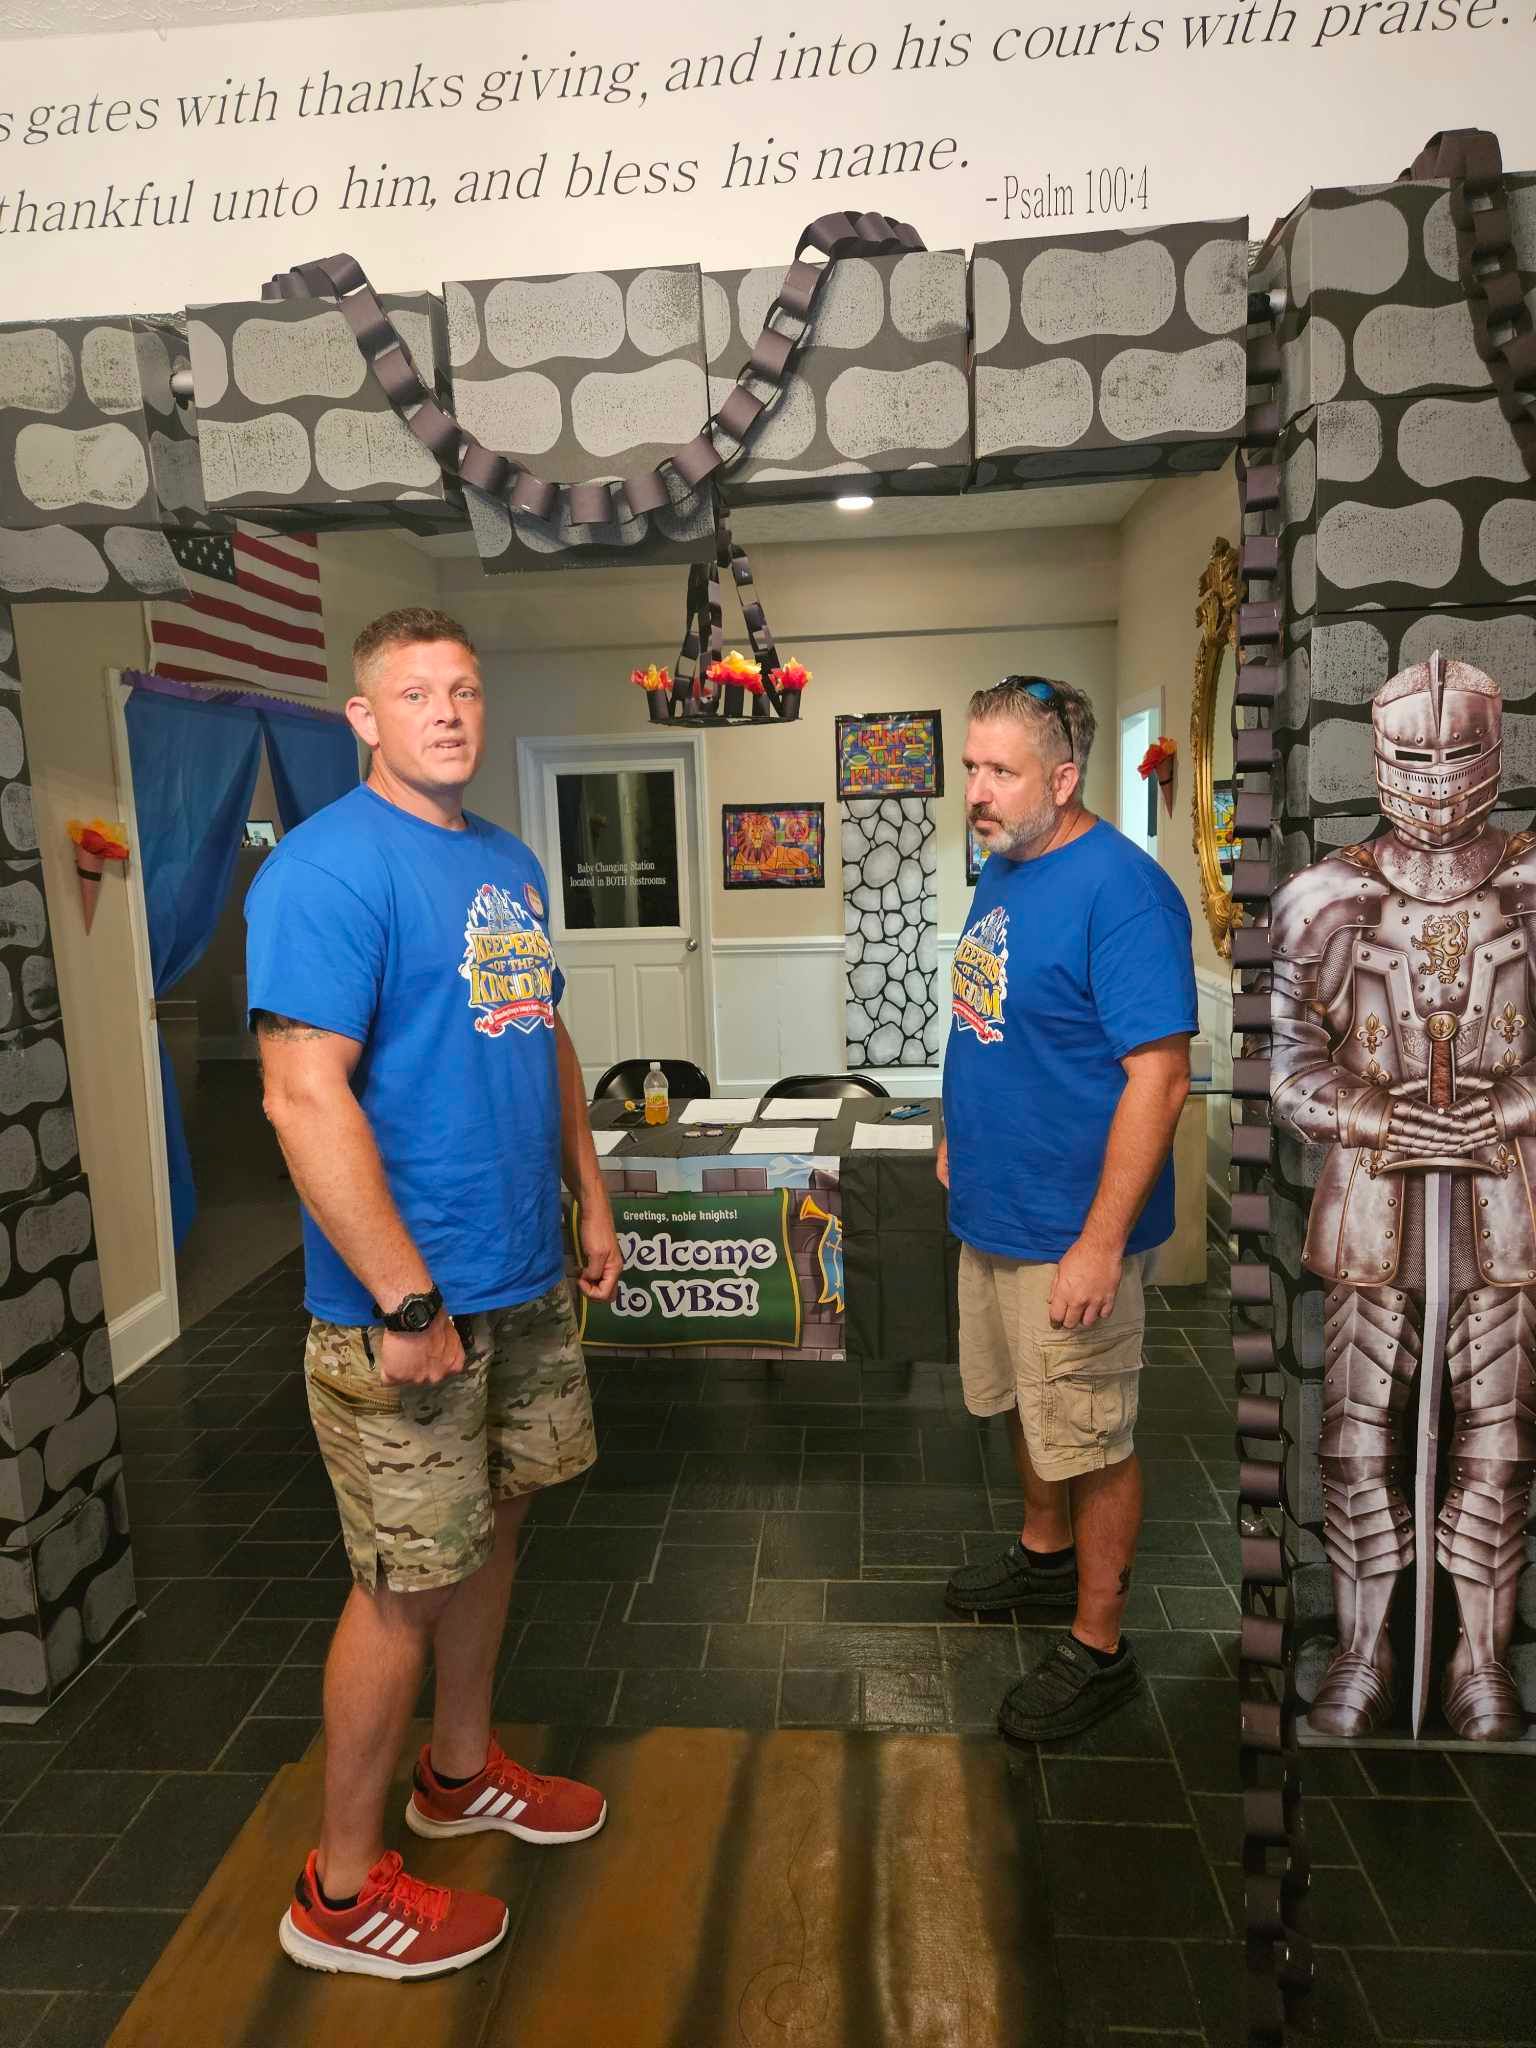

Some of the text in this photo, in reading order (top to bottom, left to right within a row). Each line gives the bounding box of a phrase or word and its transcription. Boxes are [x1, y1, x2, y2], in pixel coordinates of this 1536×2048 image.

[23, 93, 160, 146] gates
[177, 76, 278, 129] with
[298, 62, 464, 118] thanks
[475, 50, 648, 112] giving,
[664, 34, 764, 93] and
[771, 31, 877, 81] into
[891, 18, 972, 71] his
[992, 10, 1164, 63] courts
[1182, 0, 1297, 49] with
[1311, 0, 1509, 48] praise.
[213, 176, 318, 223] unto
[337, 163, 437, 212] him,
[453, 151, 548, 204] and
[564, 149, 699, 199] bless
[720, 137, 799, 189] his
[811, 137, 969, 181] name.
[1085, 164, 1149, 215] 100:4
[570, 876, 666, 887] located in BOTH Restrooms
[577, 860, 655, 875] Baby Changing Station
[471, 931, 549, 963] KEEPERS
[493, 957, 536, 973] OF THE
[623, 1209, 738, 1224] Greetings, noble knights!
[615, 1283, 754, 1313] to VBS!
